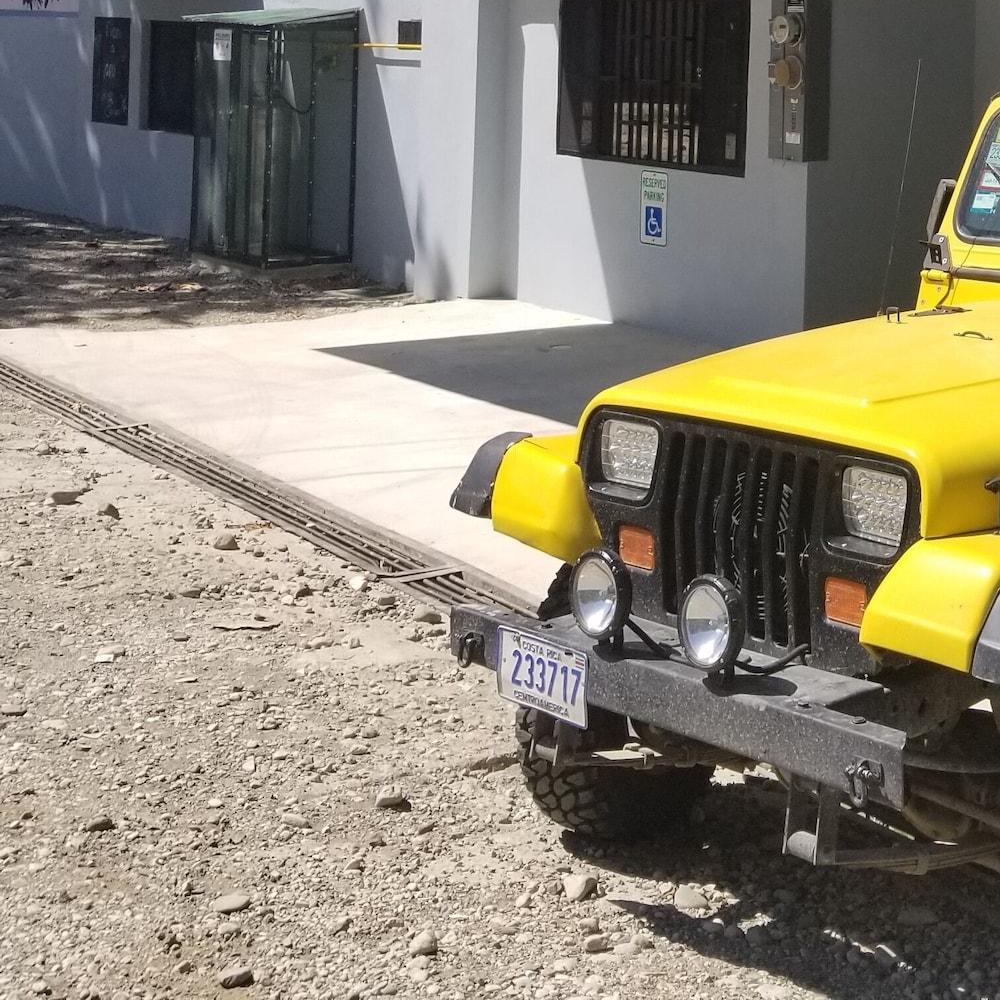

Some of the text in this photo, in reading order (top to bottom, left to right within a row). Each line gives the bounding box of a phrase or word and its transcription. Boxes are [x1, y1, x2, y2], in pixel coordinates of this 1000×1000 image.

[522, 640, 562, 663] COSTA RICA
[511, 649, 582, 706] 233717
